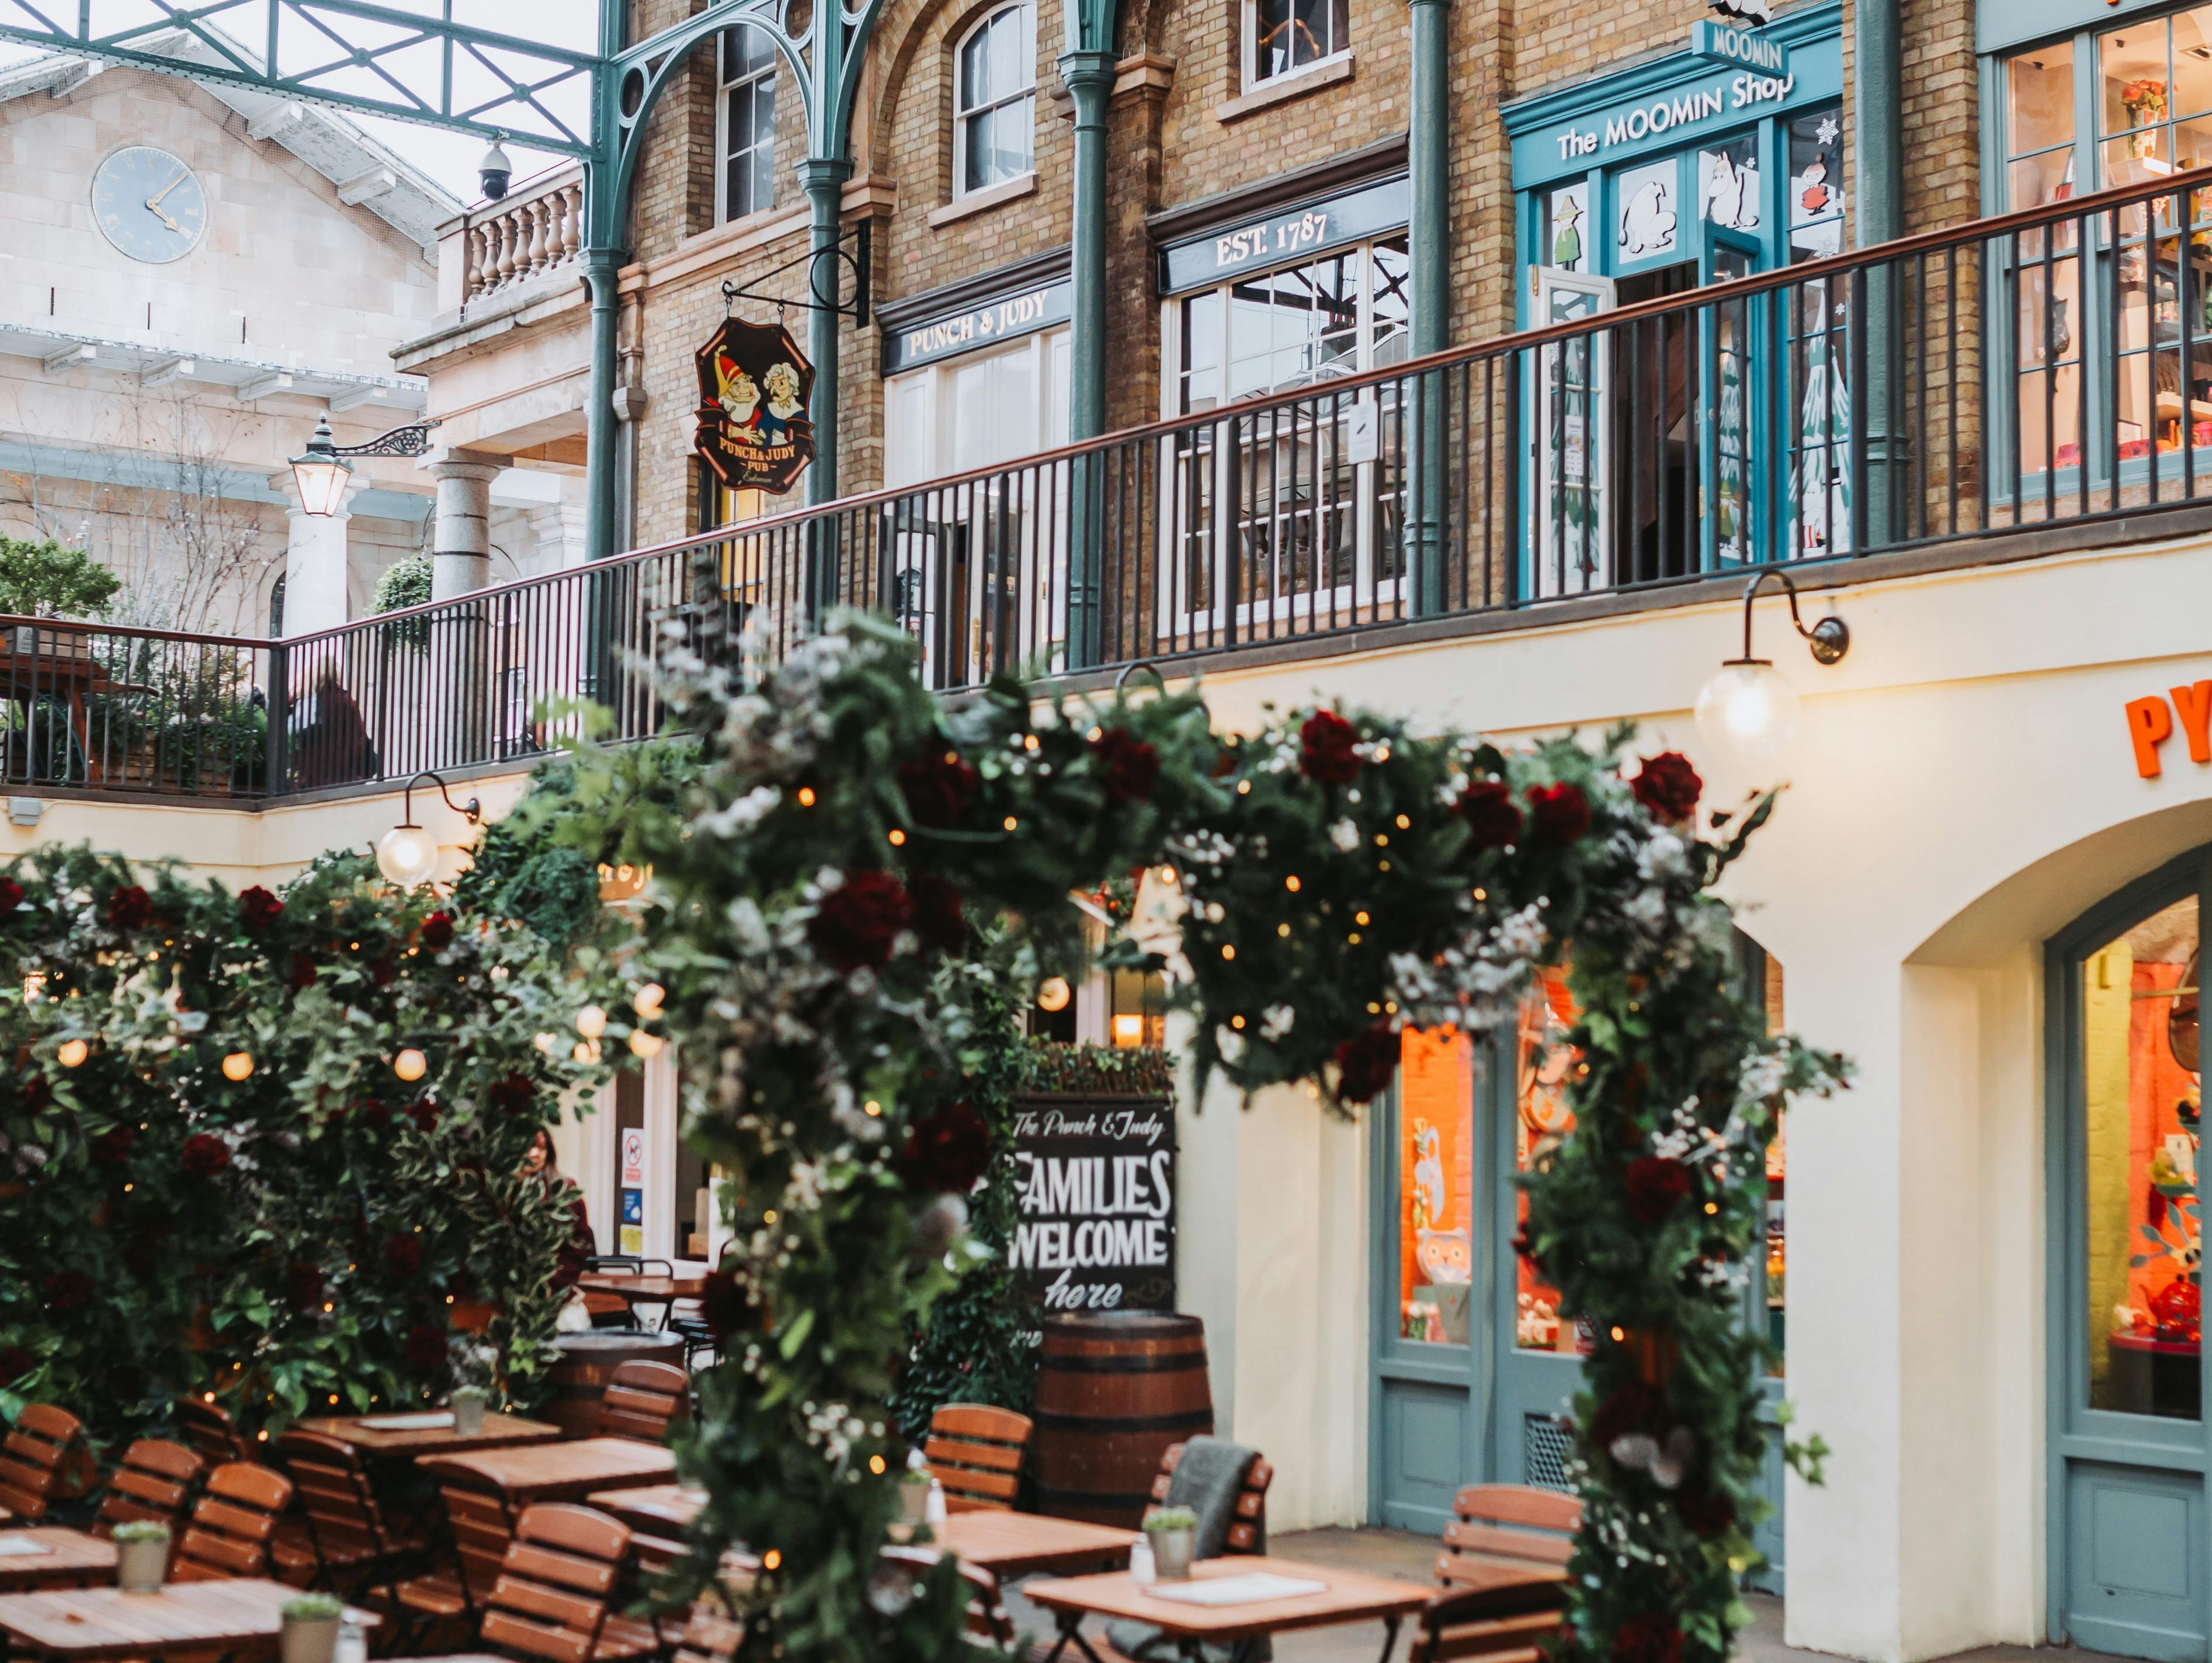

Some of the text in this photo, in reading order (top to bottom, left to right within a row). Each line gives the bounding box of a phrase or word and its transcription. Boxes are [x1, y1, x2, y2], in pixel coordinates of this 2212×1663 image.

[1713, 26, 1782, 70] MOOMIN
[1557, 72, 1794, 160] The MOOMIN Shop
[1216, 212, 1328, 267] EST. 1787
[909, 290, 1048, 357] PUNCH & JUDY
[720, 438, 758, 460] PUNCH
[766, 445, 795, 460] JUDY
[748, 460, 769, 471] PUB
[2125, 679, 2212, 779] PY
[1012, 1111, 1039, 1138] The
[1043, 1109, 1096, 1137] Punch
[1113, 1110, 1164, 1147] Judy
[1008, 1220, 1168, 1269] WELCOME
[1044, 1268, 1122, 1308] here
